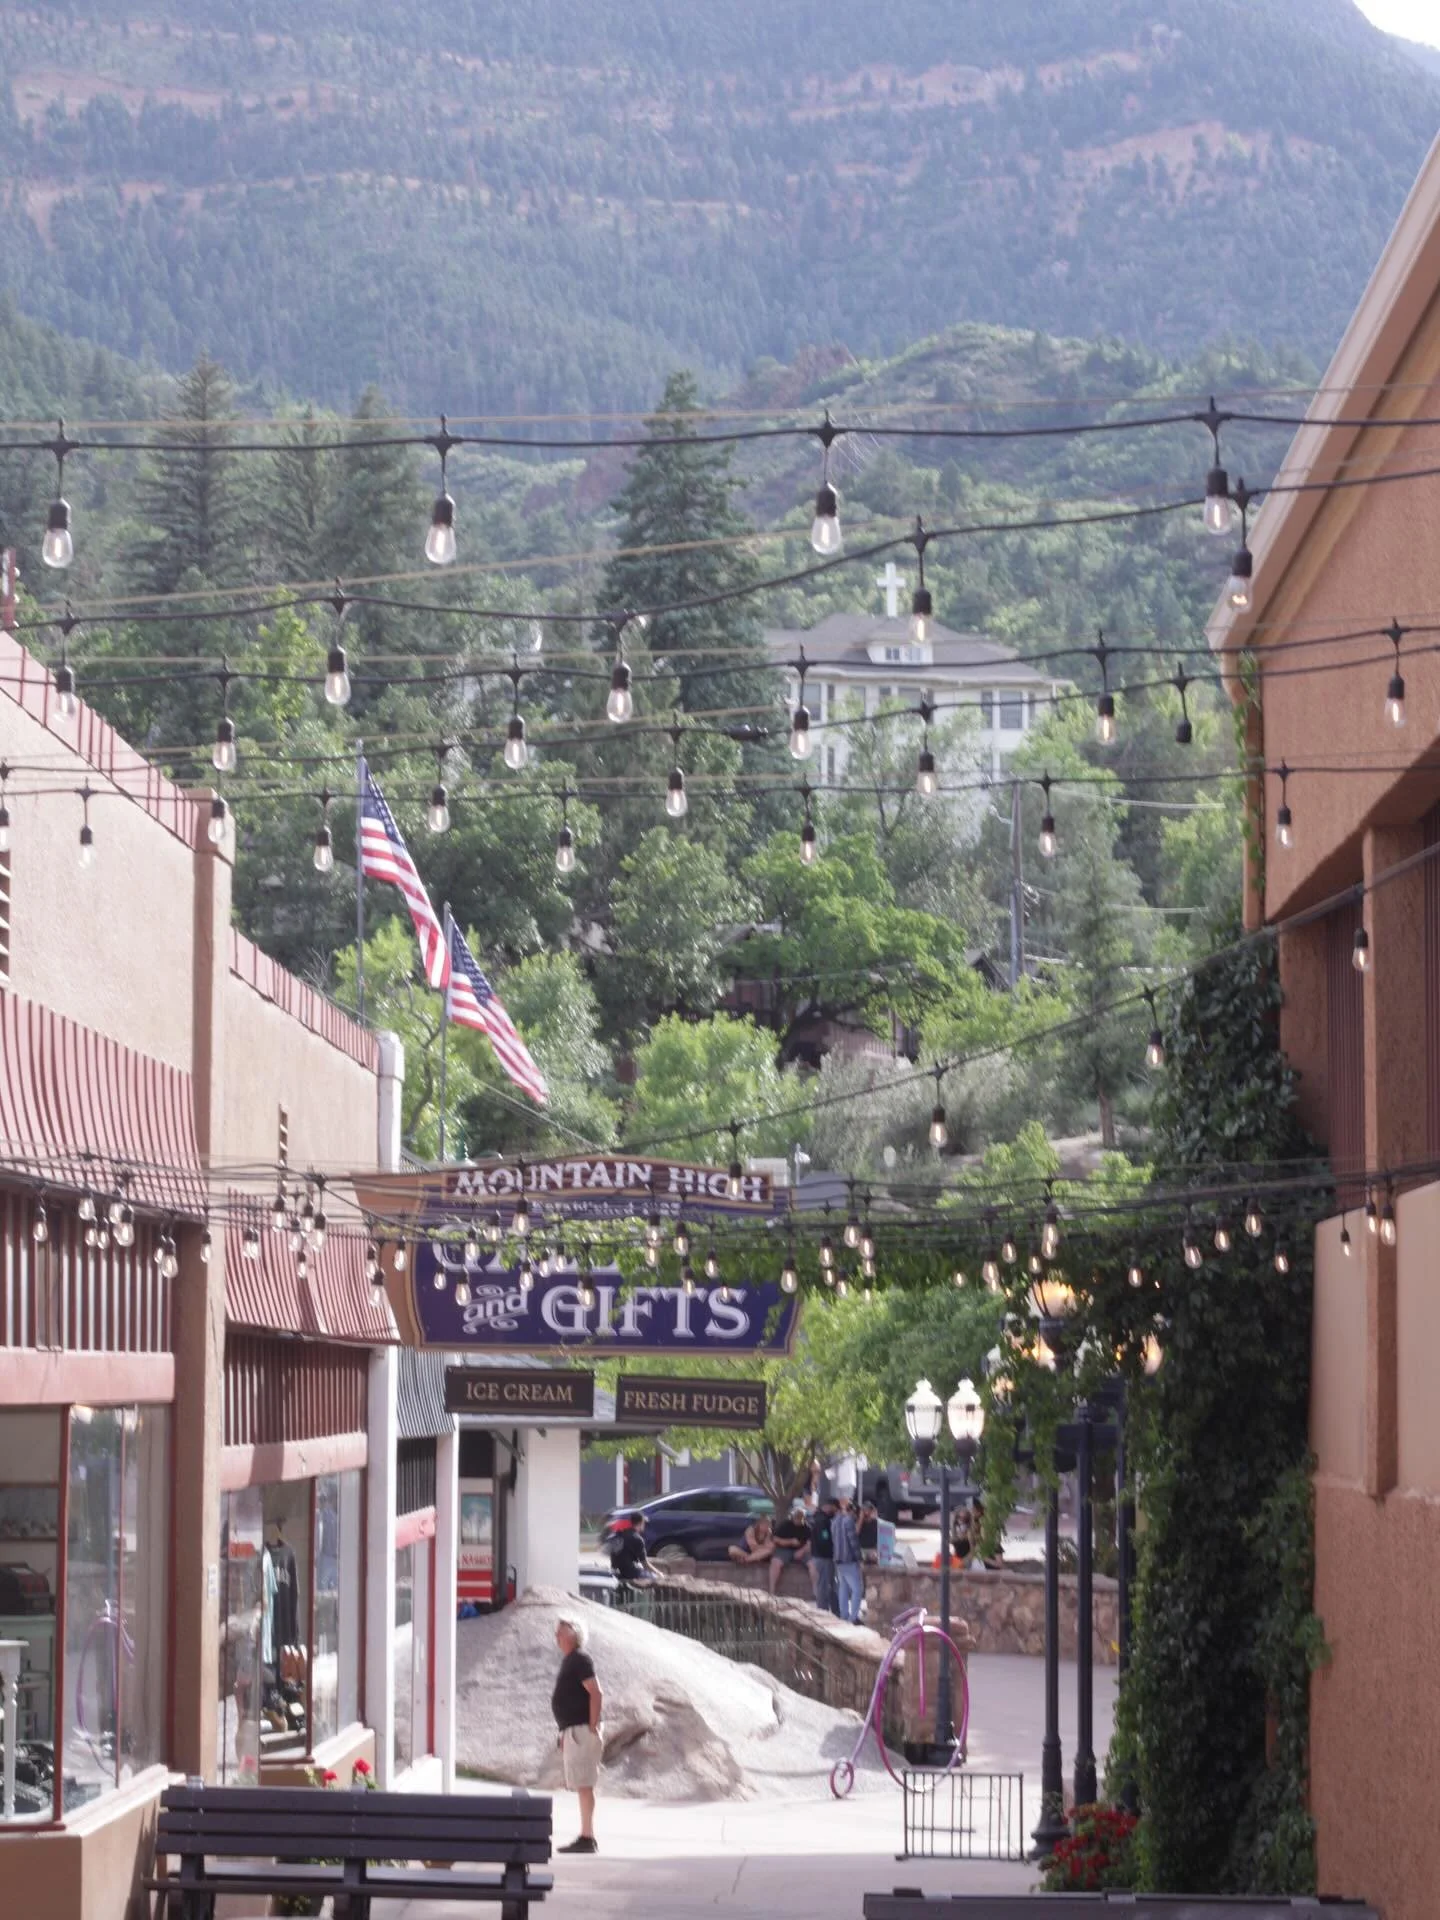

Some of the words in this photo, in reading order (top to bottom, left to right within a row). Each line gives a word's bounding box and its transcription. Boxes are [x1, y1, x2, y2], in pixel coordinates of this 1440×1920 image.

[454, 1160, 652, 1197] MOUNTAIN
[667, 1166, 764, 1203] HIGH
[463, 1284, 529, 1334] and
[541, 1284, 751, 1339] GIFTS
[466, 1381, 499, 1401] ICE
[504, 1382, 573, 1404] CREAM
[623, 1390, 686, 1411] FRESH
[692, 1394, 759, 1416] FUDGE
